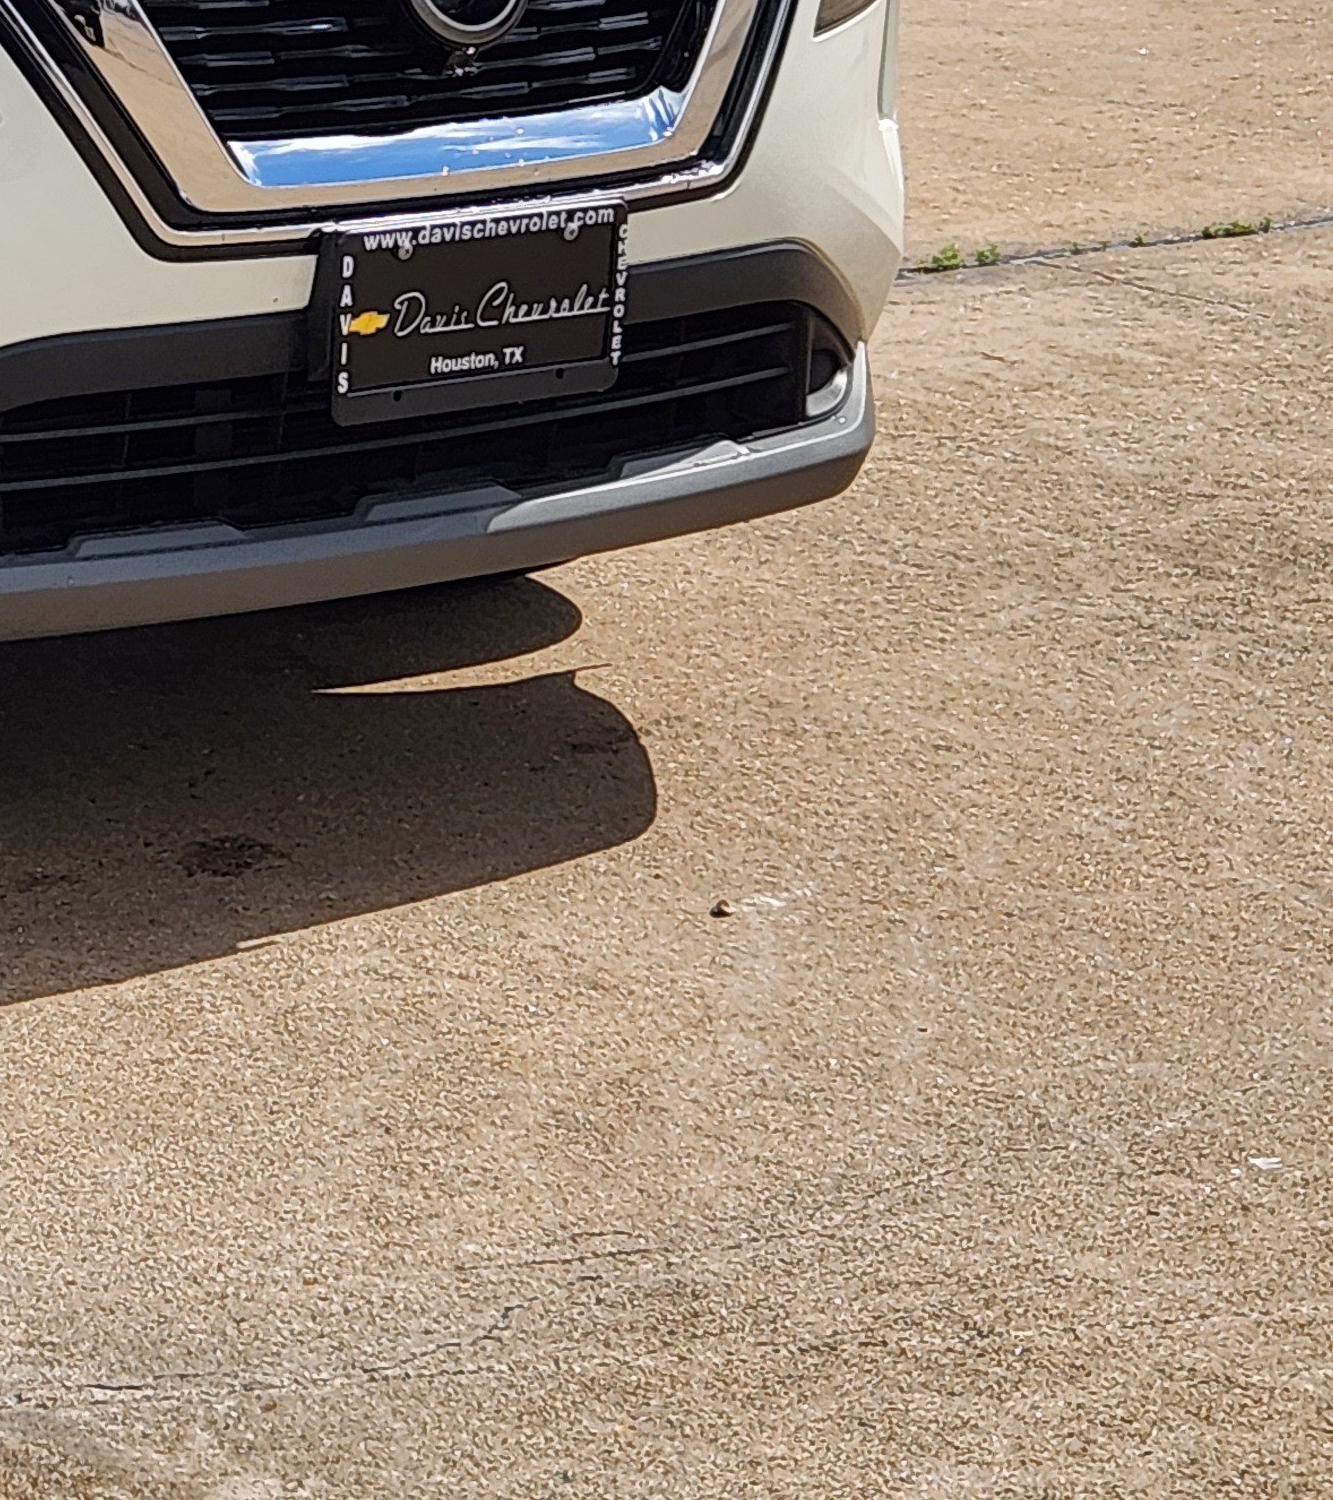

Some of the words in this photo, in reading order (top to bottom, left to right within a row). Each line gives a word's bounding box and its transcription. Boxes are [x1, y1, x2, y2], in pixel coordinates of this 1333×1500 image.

[363, 207, 615, 251] www.davischevrolet.com
[336, 255, 355, 394] DAVIS
[393, 291, 475, 337] Davis
[476, 281, 611, 326] Chevrolet
[429, 352, 499, 375] Houston,
[502, 346, 525, 365] TX
